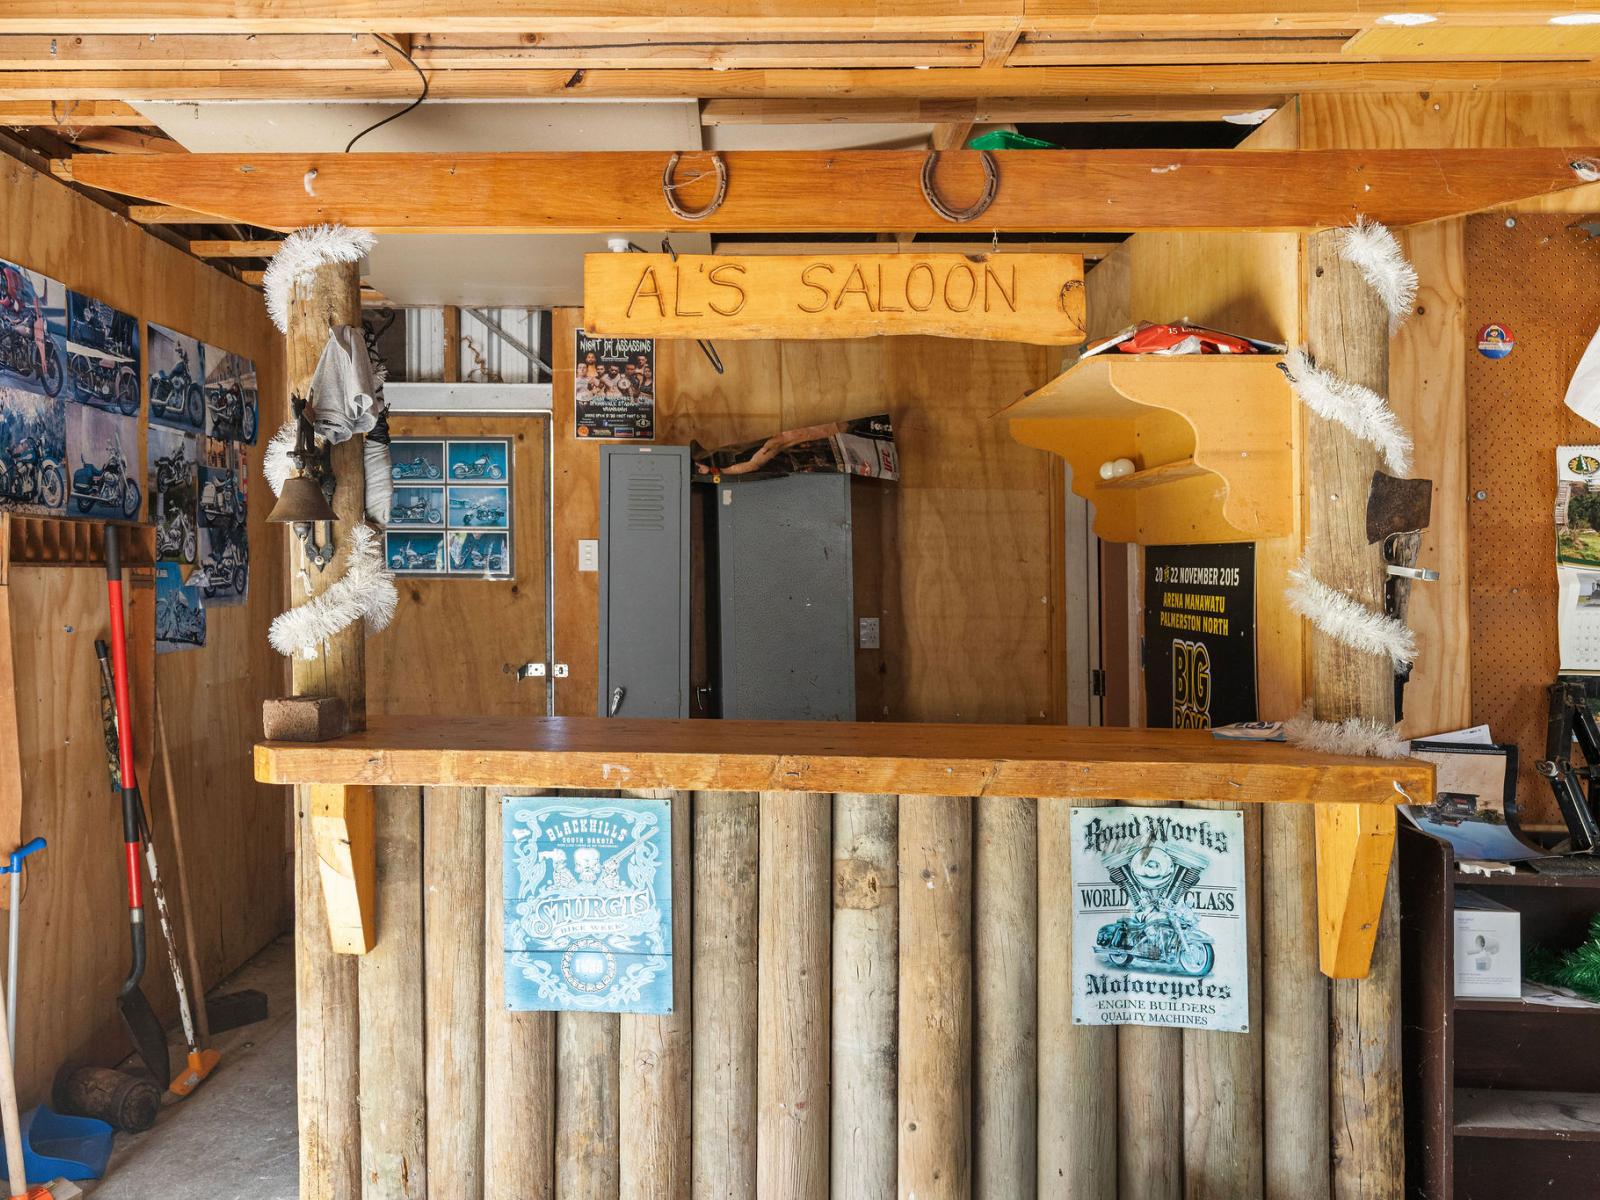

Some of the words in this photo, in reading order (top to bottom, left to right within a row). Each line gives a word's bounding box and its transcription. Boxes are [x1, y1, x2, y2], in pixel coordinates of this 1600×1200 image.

[626, 263, 747, 318] AL'S
[797, 262, 1017, 313] SALOON
[580, 338, 602, 352] NIGHT
[615, 339, 651, 353] ASSASSINS
[881, 448, 893, 472] UFC
[1154, 566, 1163, 583] 20
[1170, 567, 1179, 583] 22
[1179, 567, 1219, 586] NOVEMBER
[1219, 567, 1240, 586] 2015
[1163, 592, 1184, 608] ARENA
[1184, 594, 1226, 613] MANAWATU
[1160, 611, 1201, 632] PALMERSTON
[1202, 616, 1229, 636] NORTH
[1173, 638, 1211, 711] BIG
[545, 818, 628, 842] BLACKHILLS
[587, 837, 615, 845] DAKOTA
[1084, 814, 1142, 852] Road
[1144, 815, 1229, 854] Works
[1080, 887, 1129, 908] WORLD
[1183, 890, 1235, 912] CLASS
[537, 891, 650, 937] STURGIS
[560, 924, 585, 934] BIKE
[590, 923, 622, 931] WEEK
[1085, 973, 1232, 1000] Motorcycles
[1097, 999, 1146, 1010] ENGINE
[1149, 1001, 1217, 1015] BUILDERS
[1100, 1012, 1147, 1024] QUALITY
[1149, 1013, 1209, 1026] MACHINES
